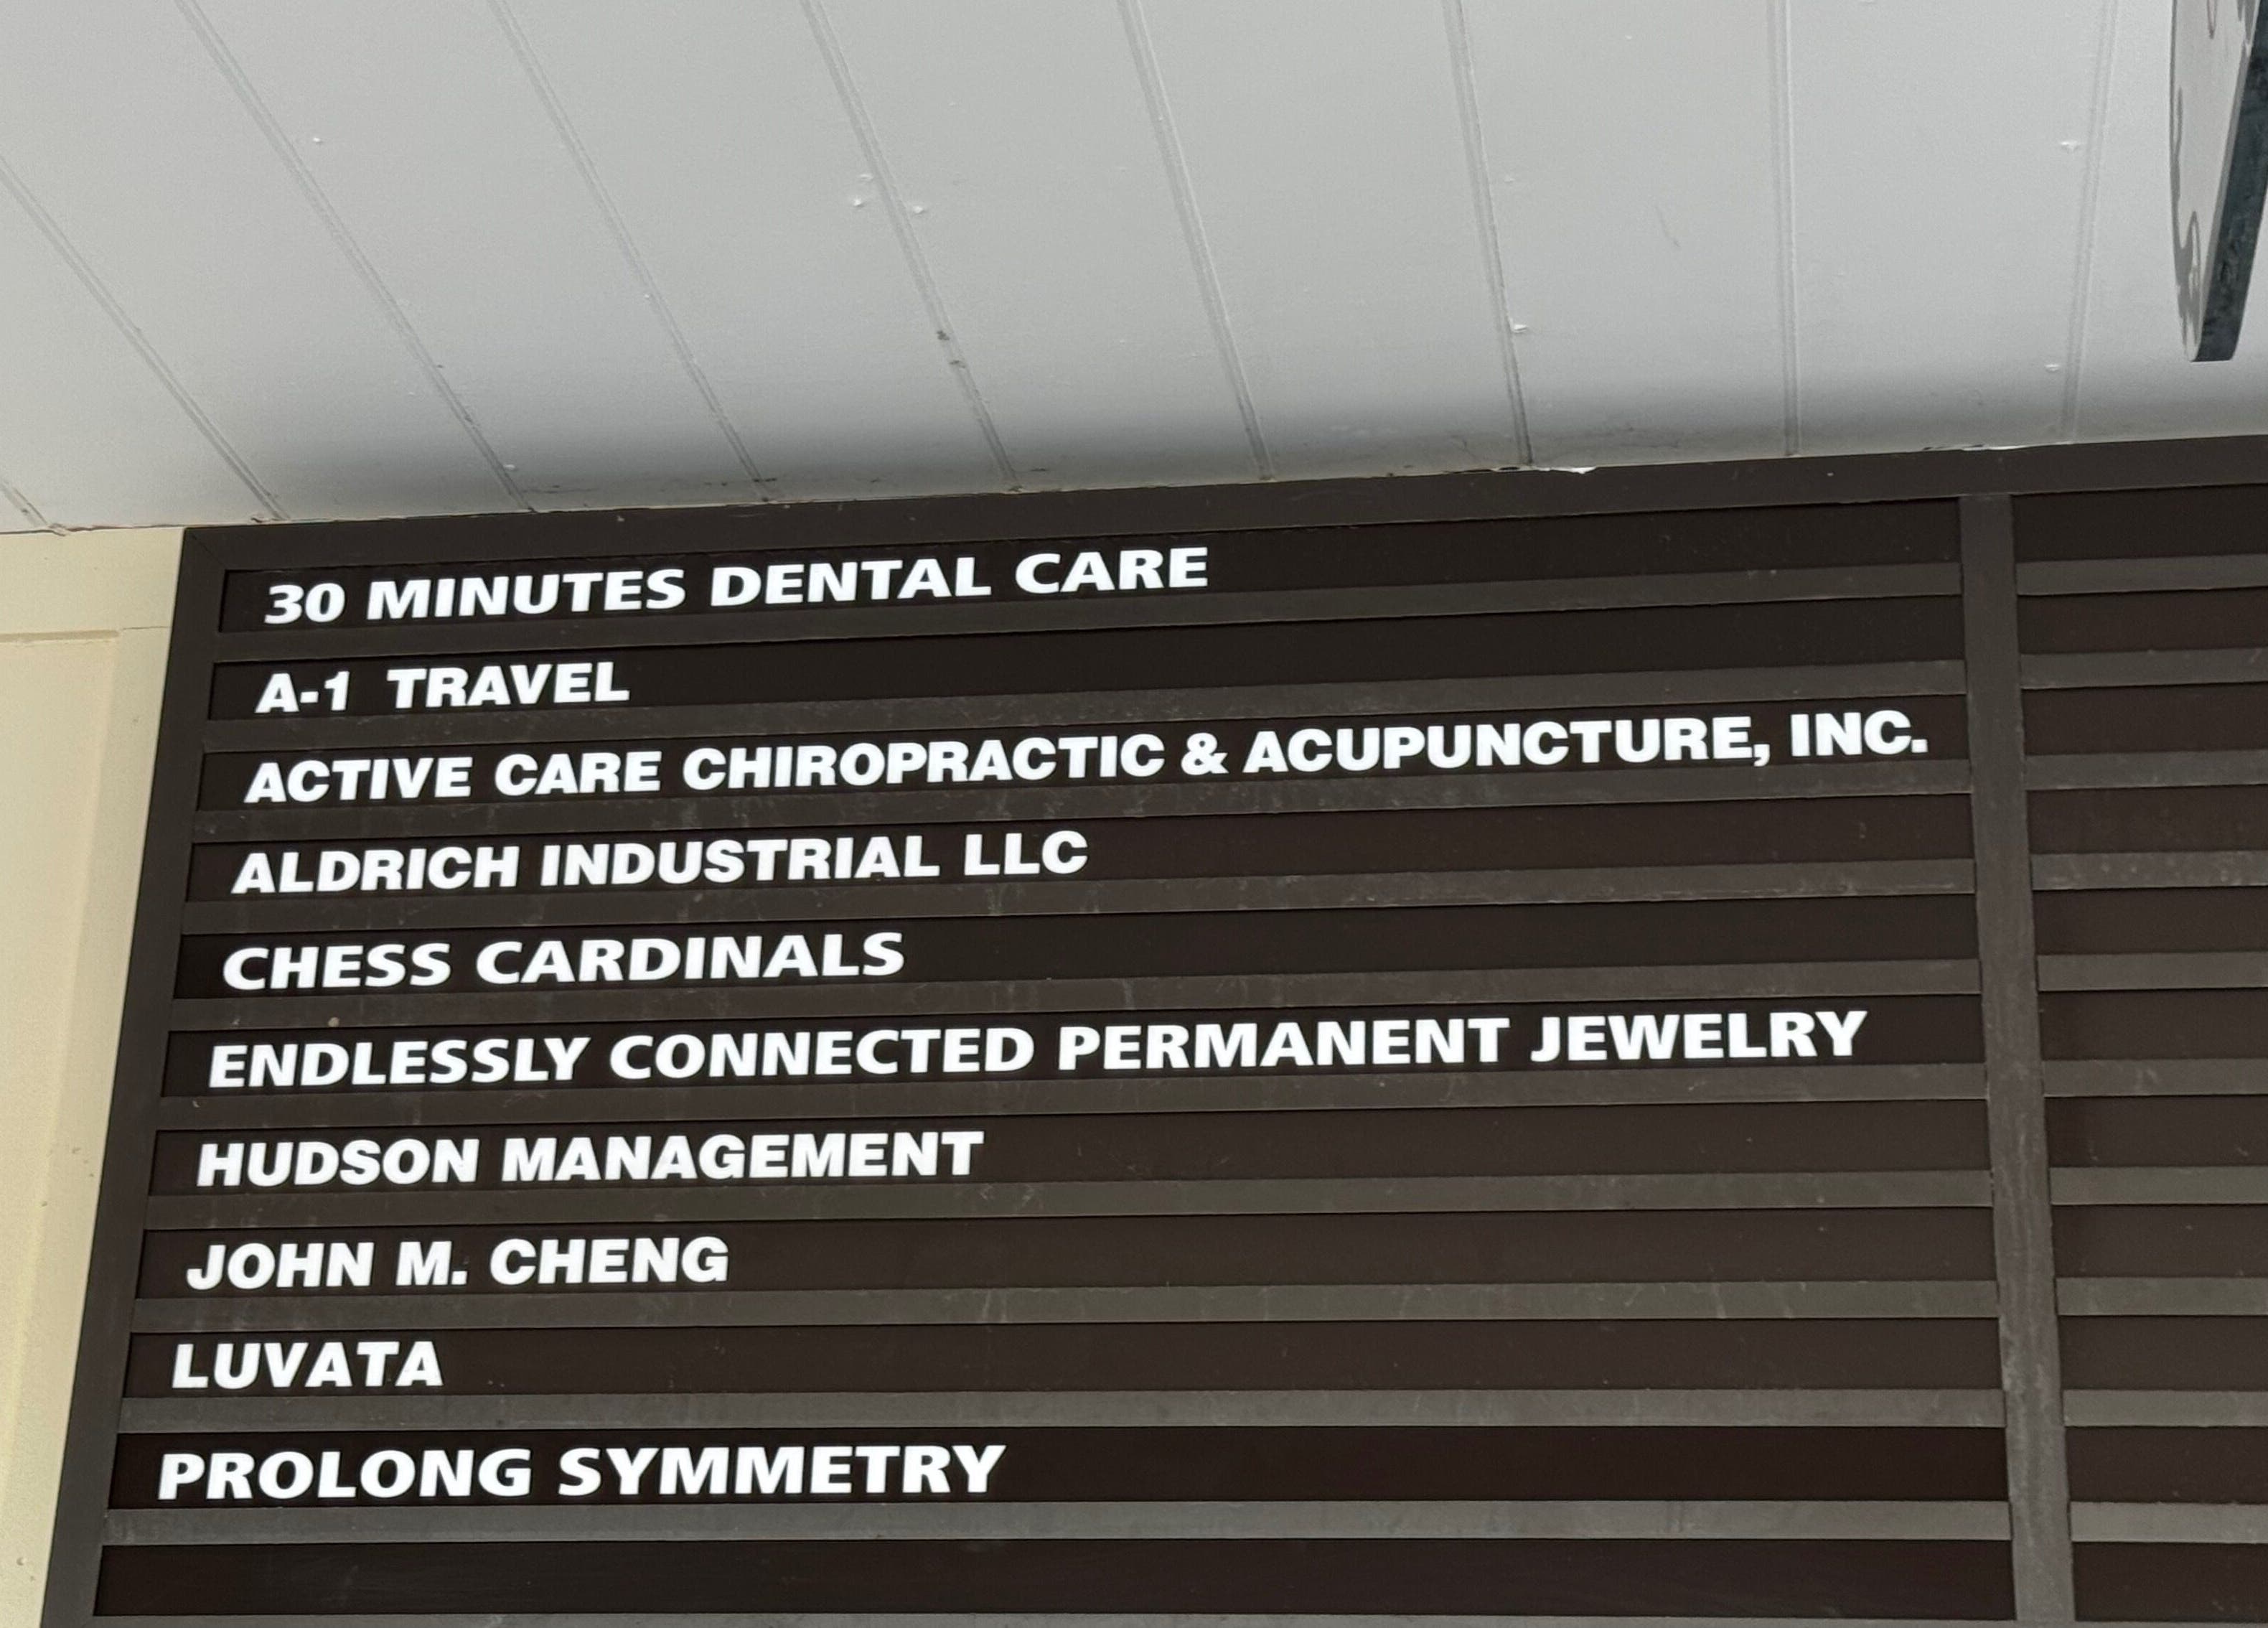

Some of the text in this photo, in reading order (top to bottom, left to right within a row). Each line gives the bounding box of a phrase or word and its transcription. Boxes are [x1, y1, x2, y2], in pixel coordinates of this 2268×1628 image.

[264, 546, 1209, 624] 30 MINUTES DENTAL CARE
[255, 660, 630, 714] A-1 TRAVEL
[243, 709, 1929, 804] ACTIVE CARE CHIROPRACTIC & ACUPUNCTURE, INC.
[230, 829, 1088, 894] ALDRICH INDUSTRIAL LLC
[222, 931, 905, 991] CHESS CARDINALS
[209, 1010, 1868, 1088] ENDLESSLY CONNECTED PERMANENT JEWELRY
[197, 1130, 985, 1187] HUDSON MANAGEMENT
[186, 1235, 729, 1291] JOHN M. CHENG
[172, 1340, 444, 1390] LUVATA
[158, 1444, 1007, 1500] PROLONG SYMMETRY
